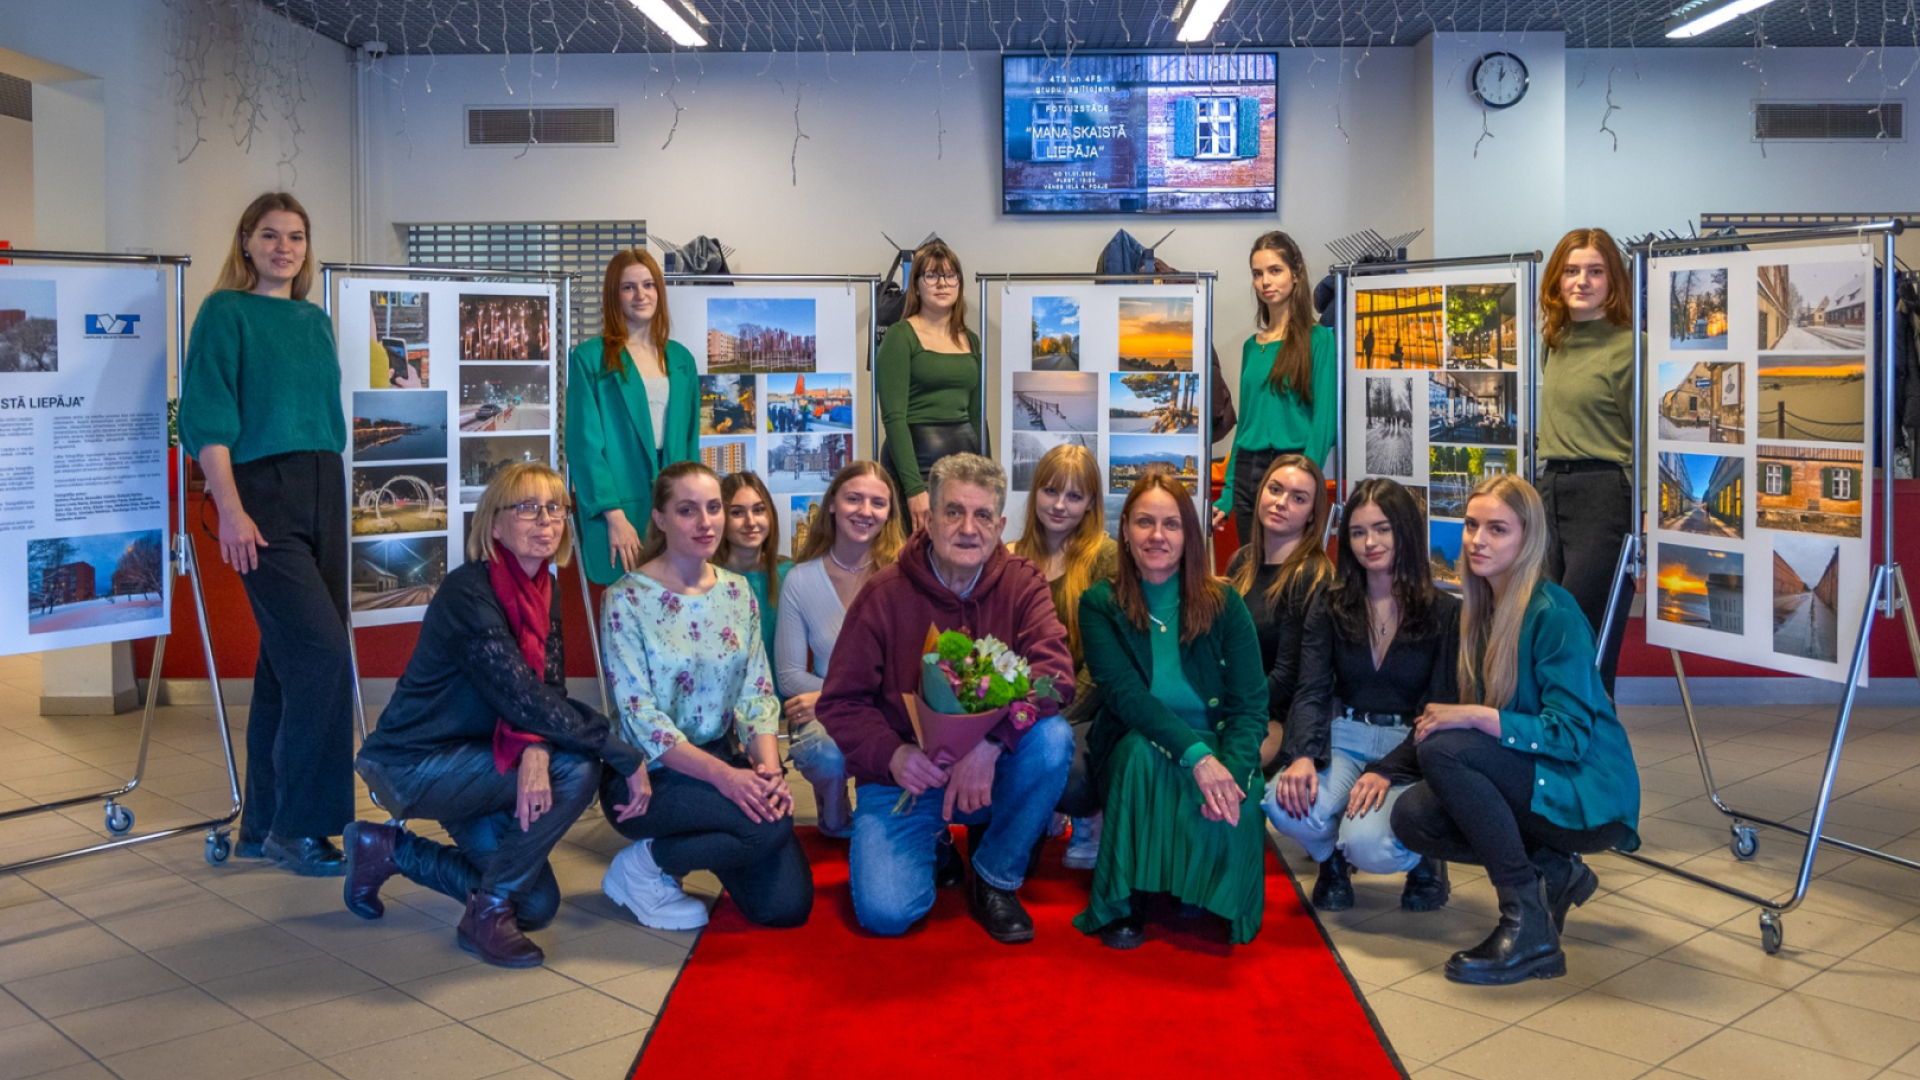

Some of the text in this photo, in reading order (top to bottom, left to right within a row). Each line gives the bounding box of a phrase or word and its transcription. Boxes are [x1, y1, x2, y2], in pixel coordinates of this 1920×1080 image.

[1049, 75, 1067, 83] 4TS
[1084, 74, 1102, 83] 4FS
[1045, 103, 1109, 112] FOTOIZSTĀDE
[1072, 124, 1127, 138] SKAISTĀ
